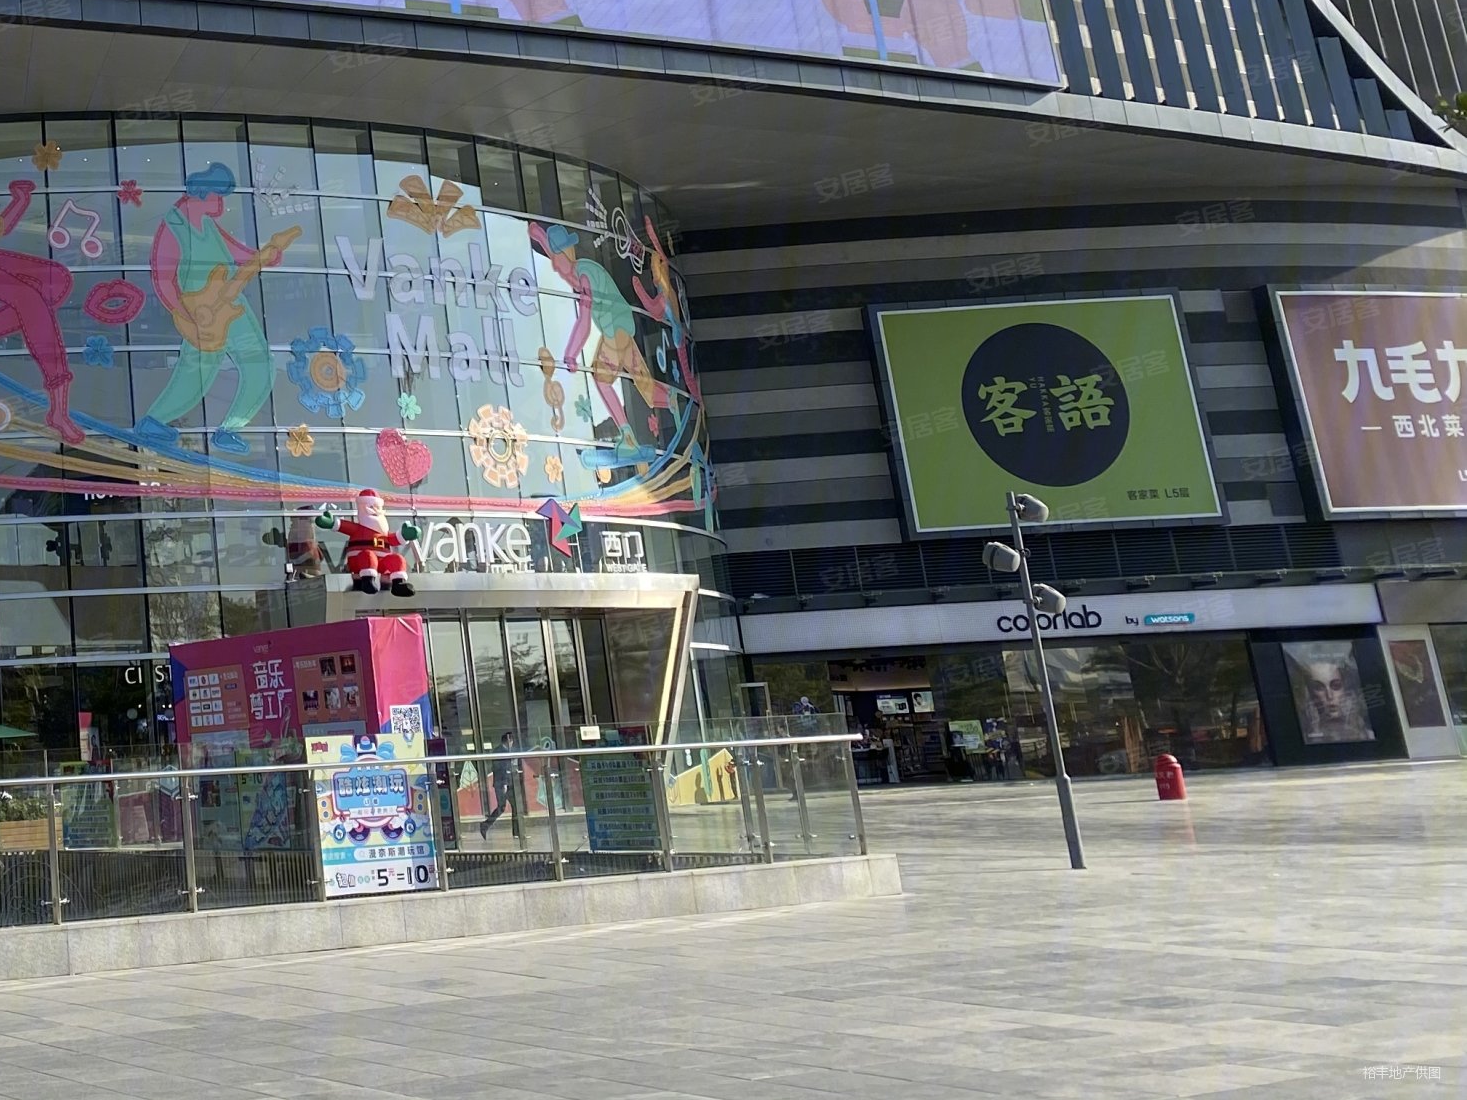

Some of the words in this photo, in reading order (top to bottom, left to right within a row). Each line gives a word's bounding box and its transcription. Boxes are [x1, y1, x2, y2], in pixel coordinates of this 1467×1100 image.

[334, 235, 538, 316] Vanke
[385, 311, 524, 387] Mall
[1392, 414, 1465, 438] 西北菜
[601, 531, 644, 559] 西门
[997, 604, 1102, 633] coorlab
[1125, 616, 1138, 626] by
[1150, 614, 1190, 624] watsons
